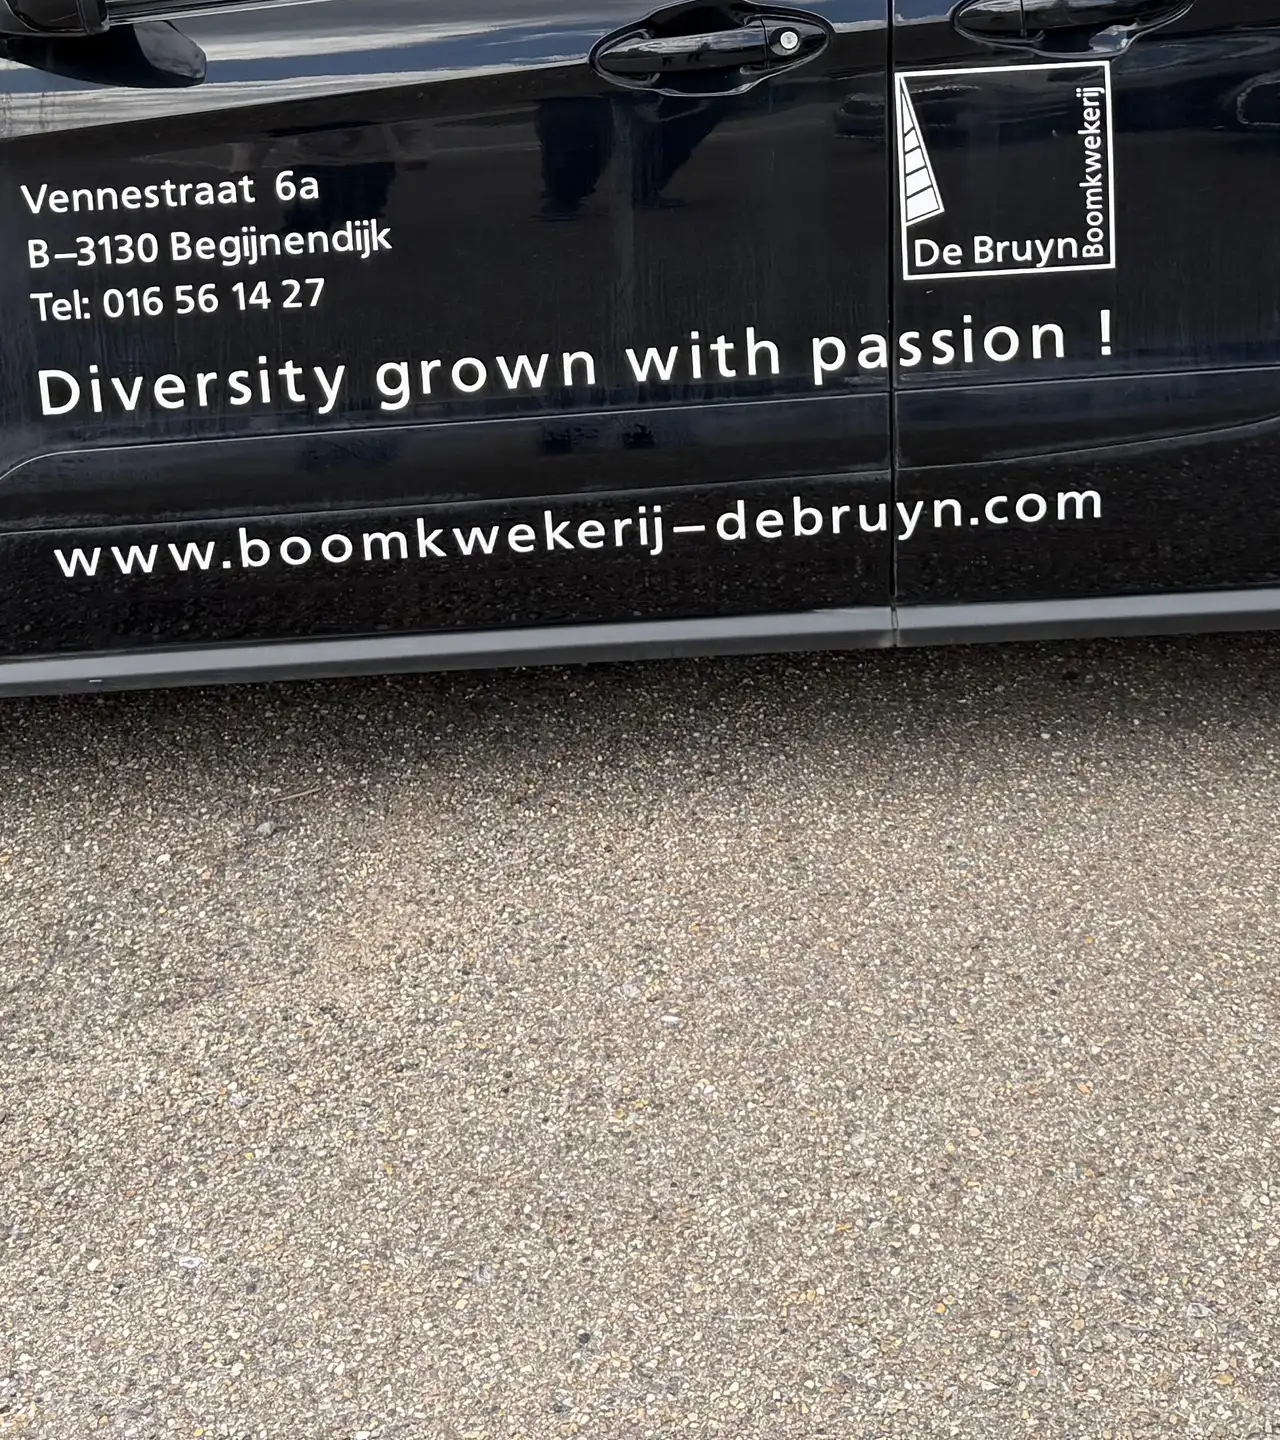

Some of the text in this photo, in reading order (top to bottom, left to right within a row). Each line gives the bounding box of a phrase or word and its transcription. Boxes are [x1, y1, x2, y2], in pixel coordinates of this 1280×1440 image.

[20, 170, 319, 214] Vennestraat 6a
[1076, 85, 1105, 259] Boomkwekerij
[28, 217, 393, 269] B-3130 Begijnendijk
[914, 235, 1078, 270] De Bruyn
[29, 277, 325, 322] Tel: 016 56 14 27
[37, 308, 1113, 417] Diversity grown with passion !
[53, 489, 1103, 578] www.boomkwekerij-debruyn.com
